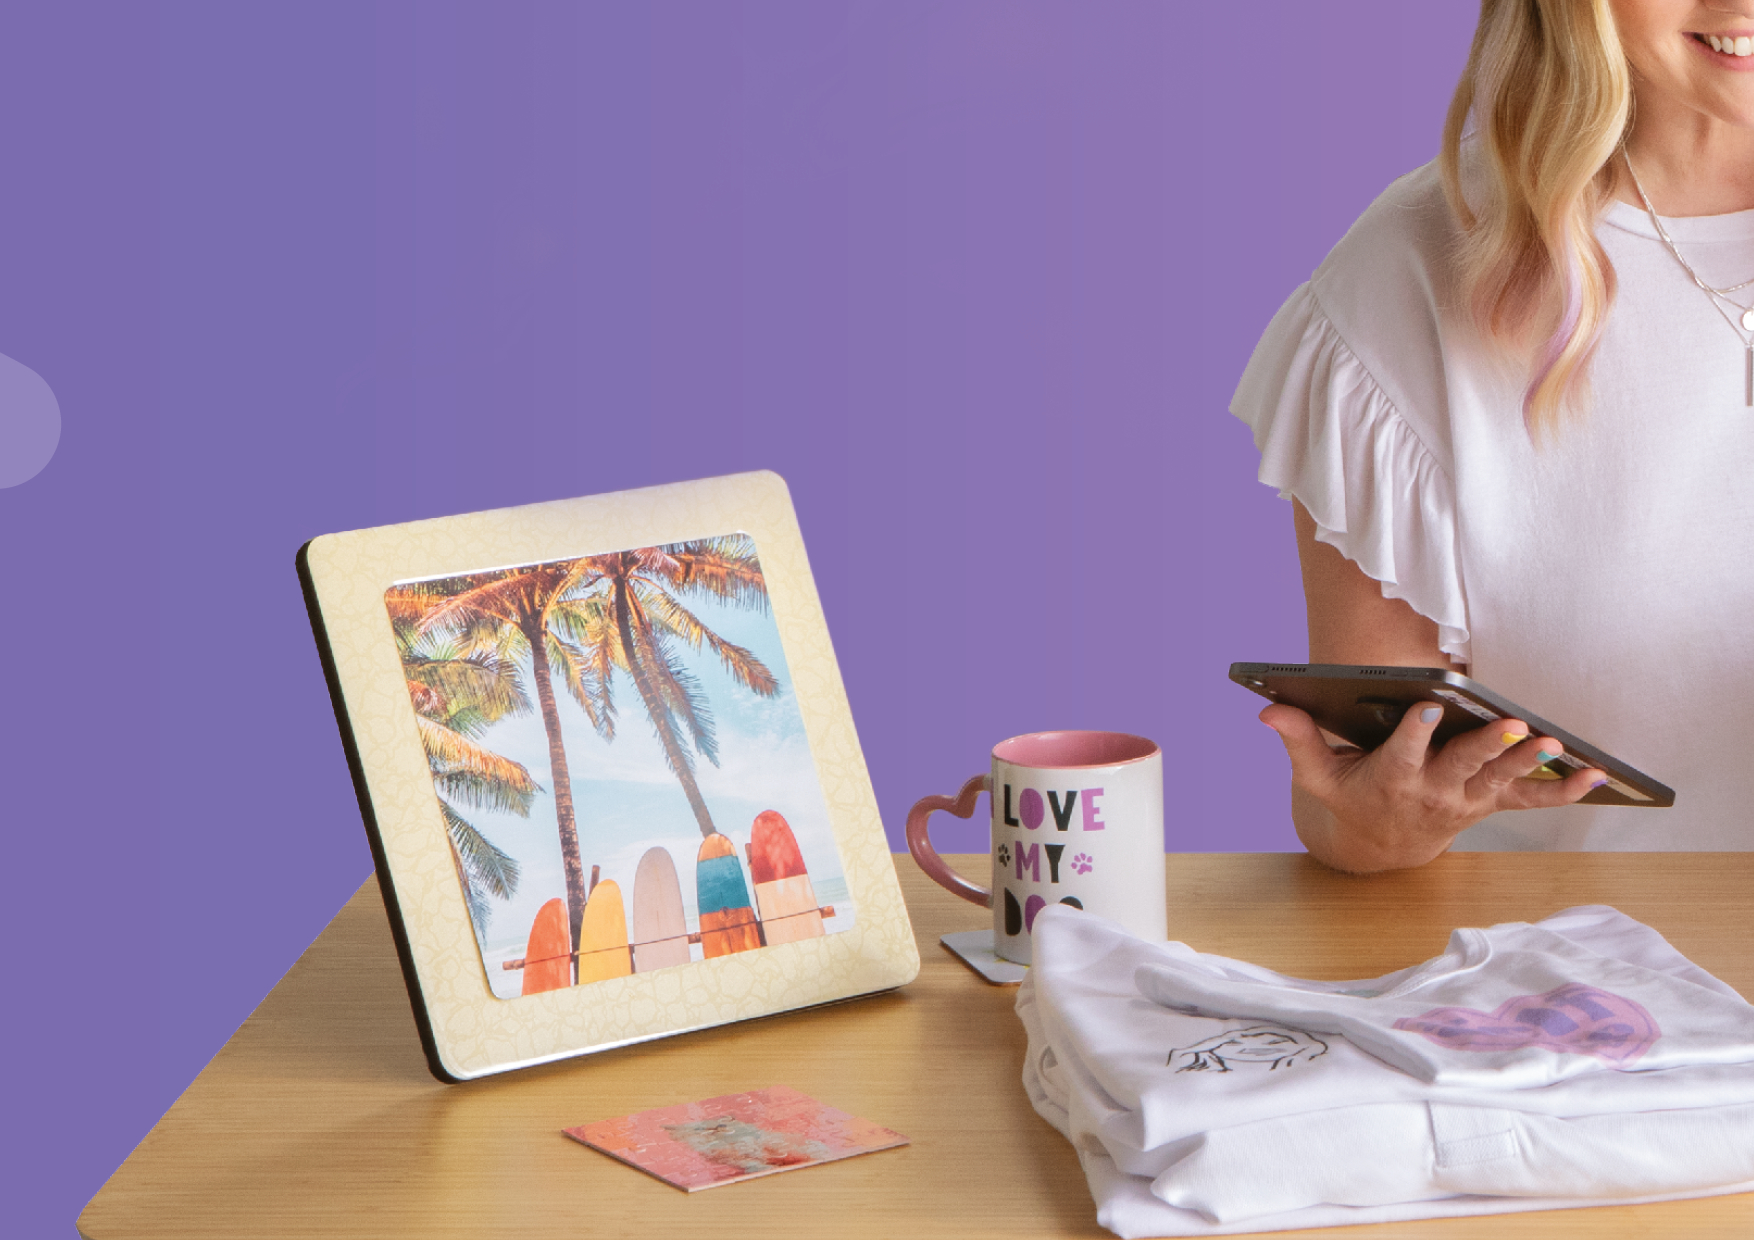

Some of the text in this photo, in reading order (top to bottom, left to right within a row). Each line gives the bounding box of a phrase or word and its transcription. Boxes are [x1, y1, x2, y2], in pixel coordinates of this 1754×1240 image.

[1004, 783, 1105, 832] LOVE
[1015, 840, 1067, 884] MY
[1004, 887, 1084, 937] DO
